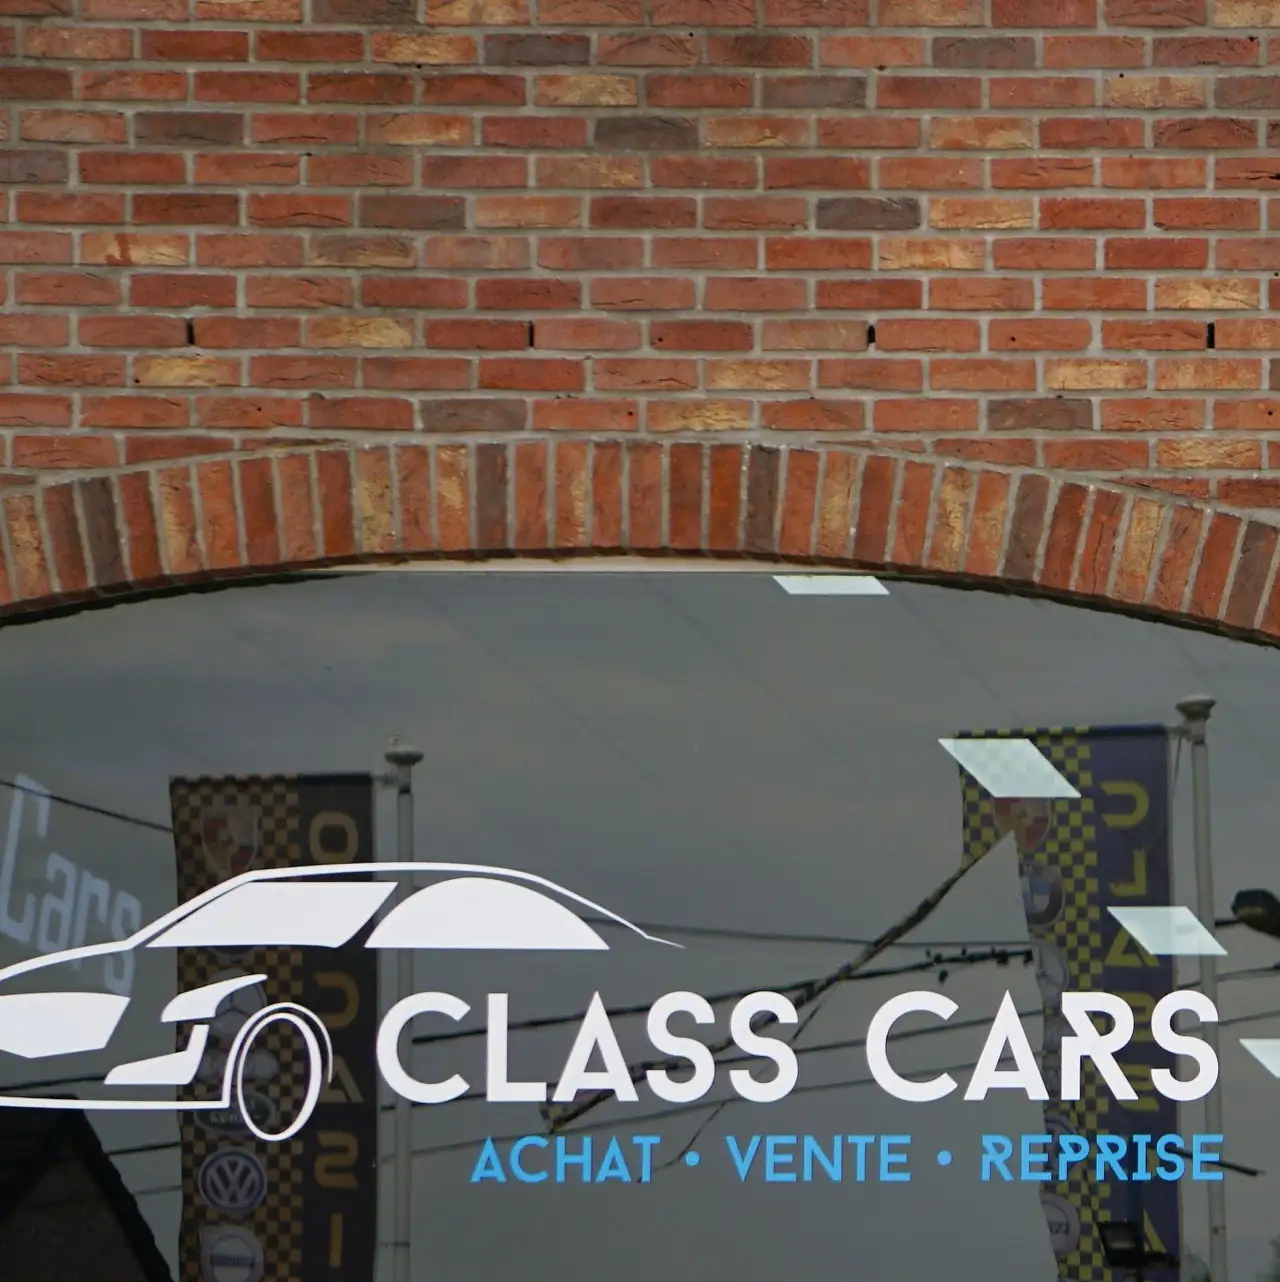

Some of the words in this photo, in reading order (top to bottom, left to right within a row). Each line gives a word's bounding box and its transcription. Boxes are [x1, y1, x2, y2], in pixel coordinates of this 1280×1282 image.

[376, 991, 799, 1104] CLASS
[865, 991, 1219, 1103] CARS
[471, 1134, 661, 1183] ACHAT
[727, 1134, 911, 1183] VENTE
[980, 1134, 1224, 1183] REPRISE
